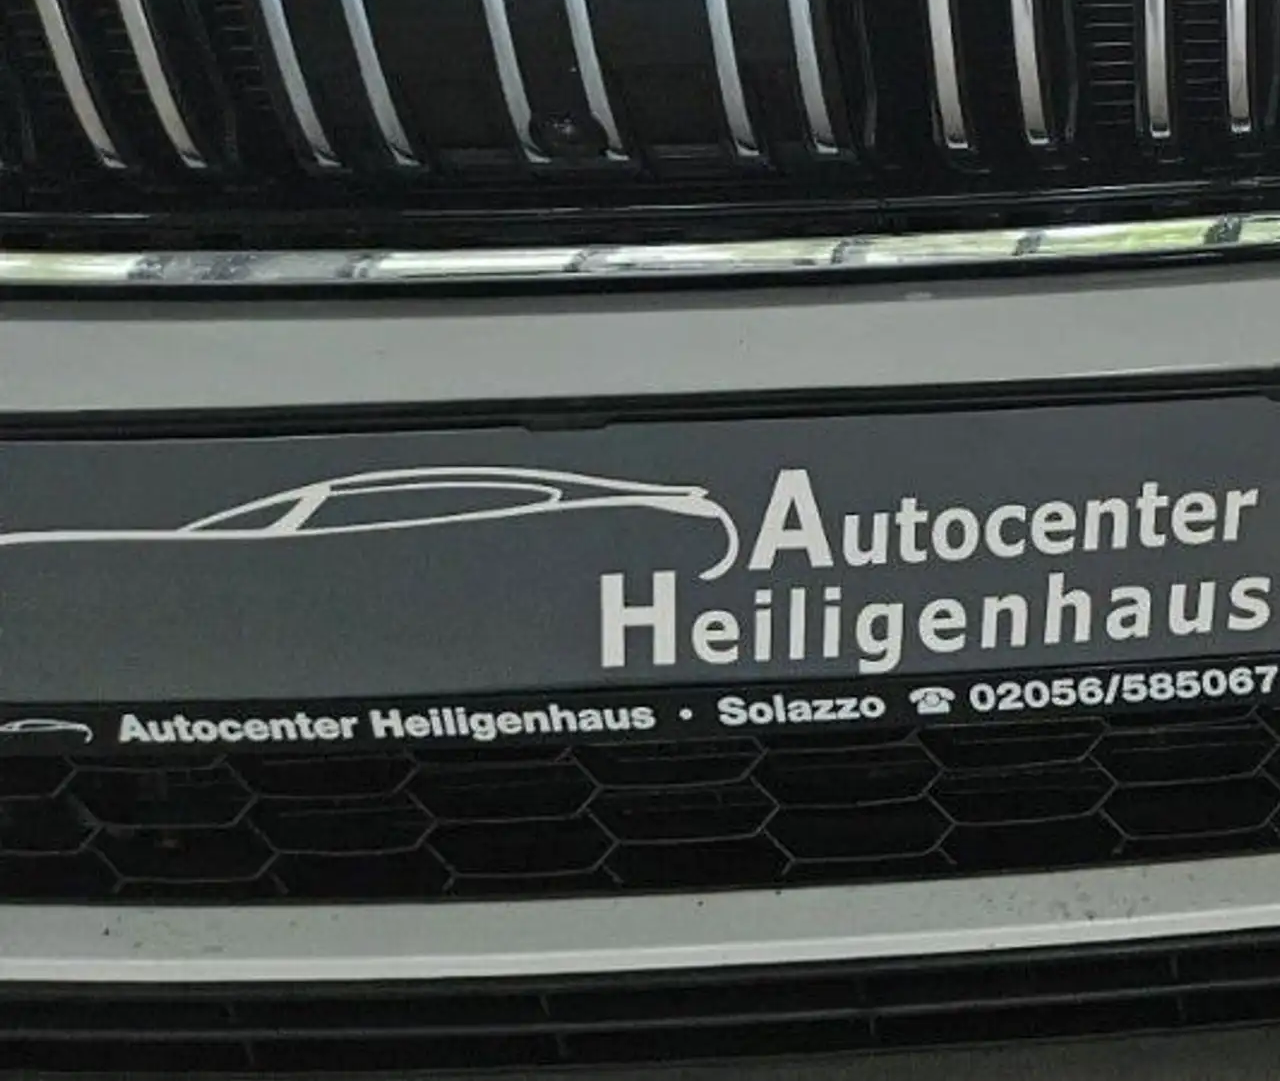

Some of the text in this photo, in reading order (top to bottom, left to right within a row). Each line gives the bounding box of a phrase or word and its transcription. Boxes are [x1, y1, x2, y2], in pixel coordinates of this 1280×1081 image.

[748, 469, 1260, 572] Autocenter
[600, 570, 1272, 674] Heiligenhaus
[118, 664, 1280, 743] Autocenter Heiligenhaus Solazzo 02056/585067
